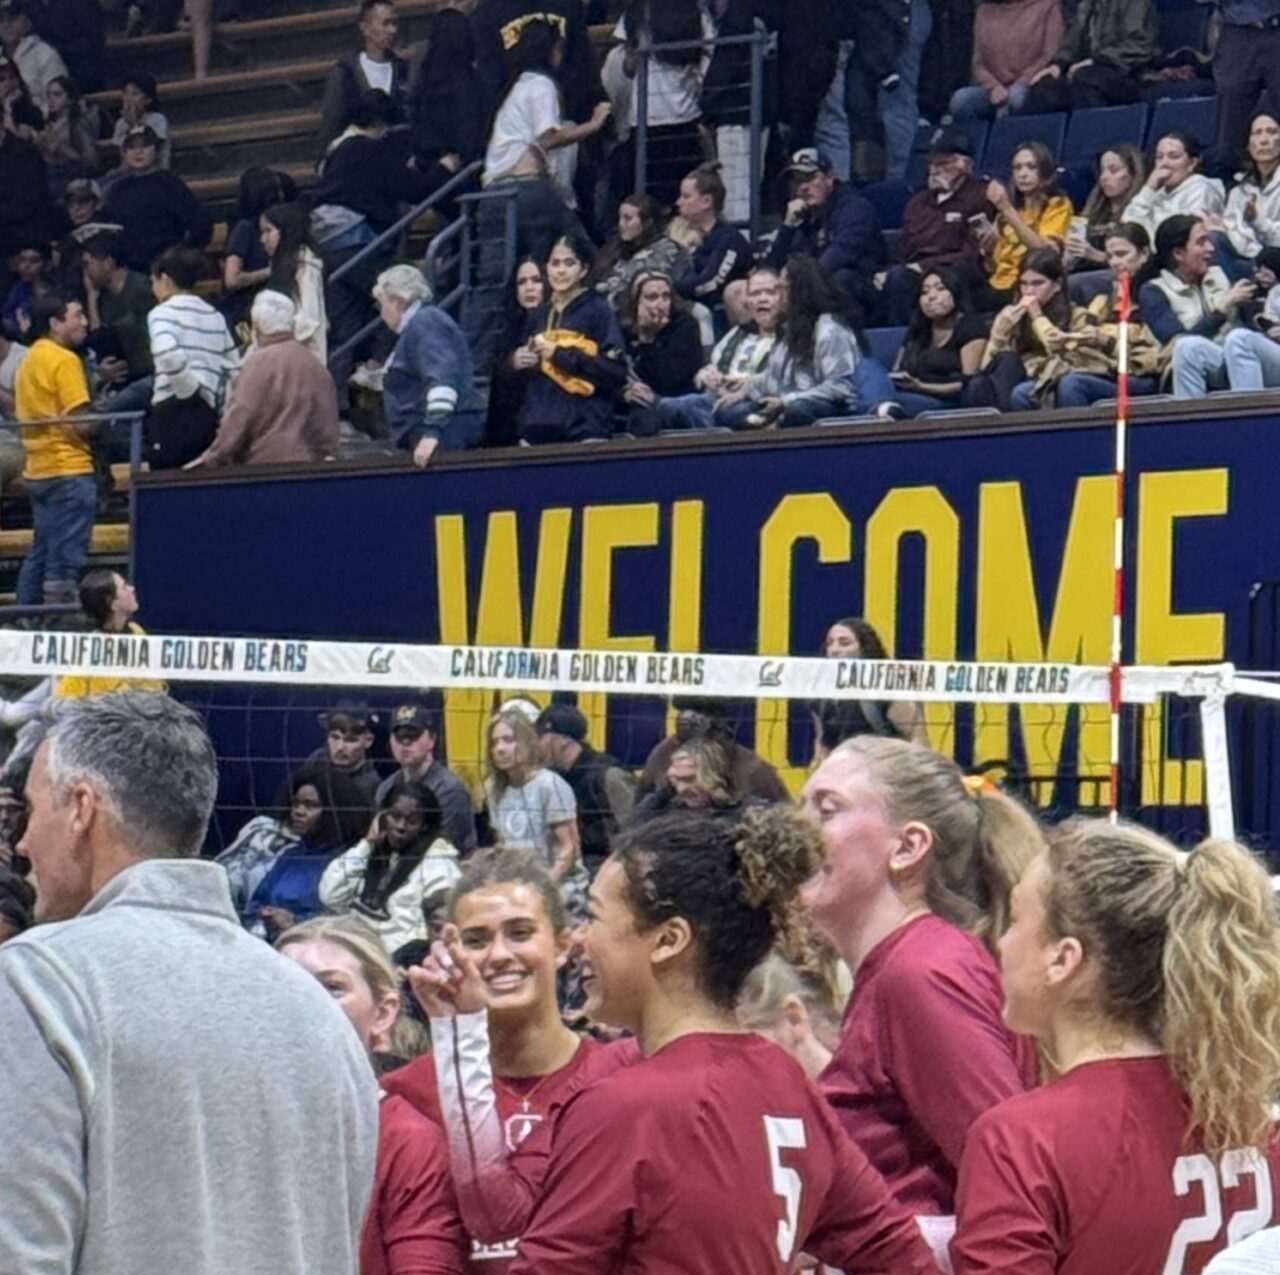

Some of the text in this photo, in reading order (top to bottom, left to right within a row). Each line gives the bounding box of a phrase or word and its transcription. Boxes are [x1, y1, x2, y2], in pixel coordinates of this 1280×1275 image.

[31, 633, 308, 673] CALIFORNIA GOLDEN BEARS
[434, 468, 1229, 807] WELCOME
[367, 647, 396, 675] Cal
[450, 648, 705, 686] CALIFORNIA GOLDEN BEARS
[758, 660, 784, 687] Cal
[835, 661, 1070, 695] CALIFORNIA GOLDEN BEARS
[763, 1114, 806, 1263] 5
